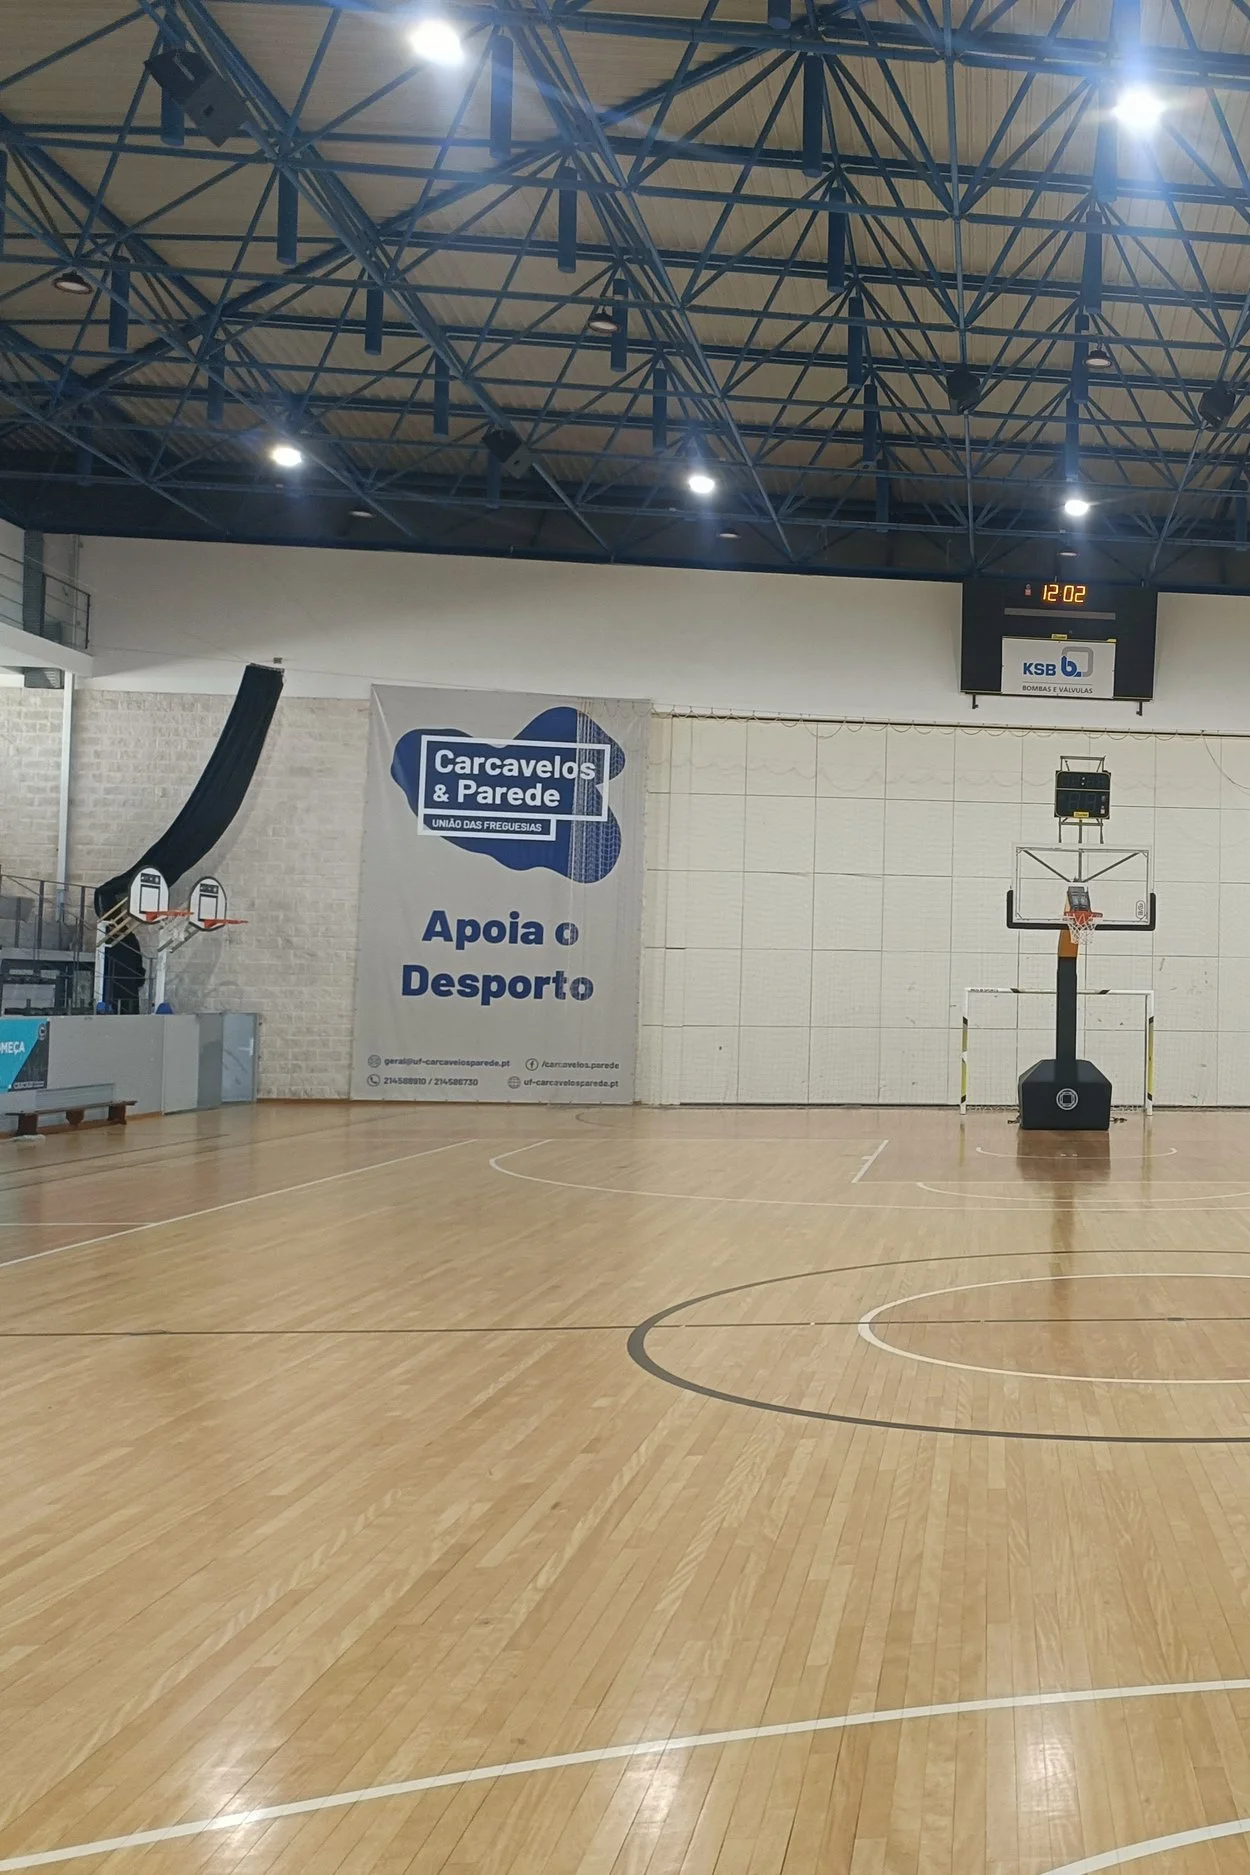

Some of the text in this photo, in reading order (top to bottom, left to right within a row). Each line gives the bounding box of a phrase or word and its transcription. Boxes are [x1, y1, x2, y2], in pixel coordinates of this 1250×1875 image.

[1043, 584, 1086, 603] 12:02
[1023, 662, 1057, 677] KSB
[1022, 685, 1051, 693] BOMBAS
[1059, 685, 1093, 694] VÁLVULAS
[434, 749, 597, 781] Carcavelos
[432, 779, 561, 808] & Parede
[432, 818, 543, 833] UNIÃO DAS FREGUESIAS
[422, 910, 580, 951] Apoia o
[401, 964, 595, 1007] Desporto
